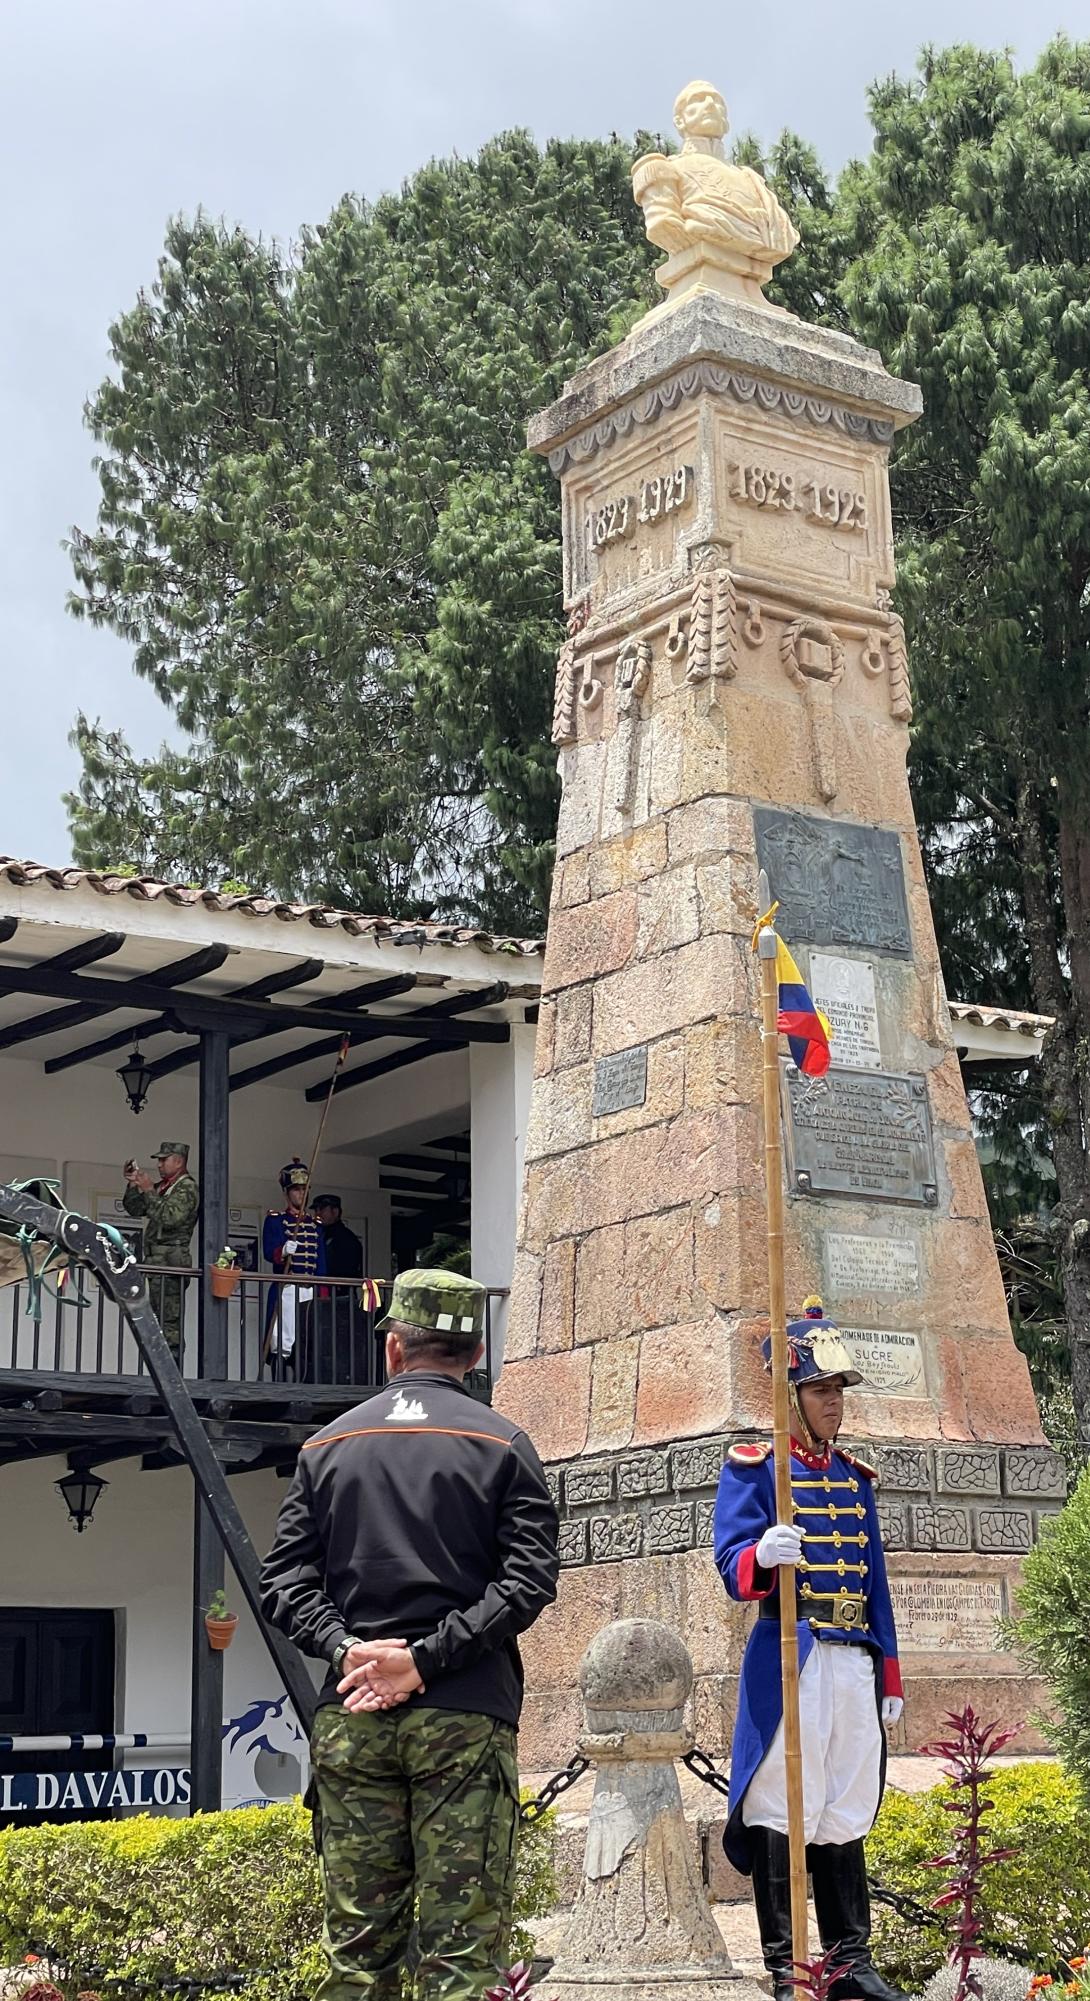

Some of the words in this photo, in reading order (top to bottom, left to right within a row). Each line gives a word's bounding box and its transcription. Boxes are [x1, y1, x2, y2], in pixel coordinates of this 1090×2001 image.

[639, 465, 691, 523] 1929
[729, 463, 801, 511] 1829
[803, 480, 867, 529] 1929
[855, 1349, 893, 1362] SUCRE
[35, 1768, 190, 1810] DAVALOS
